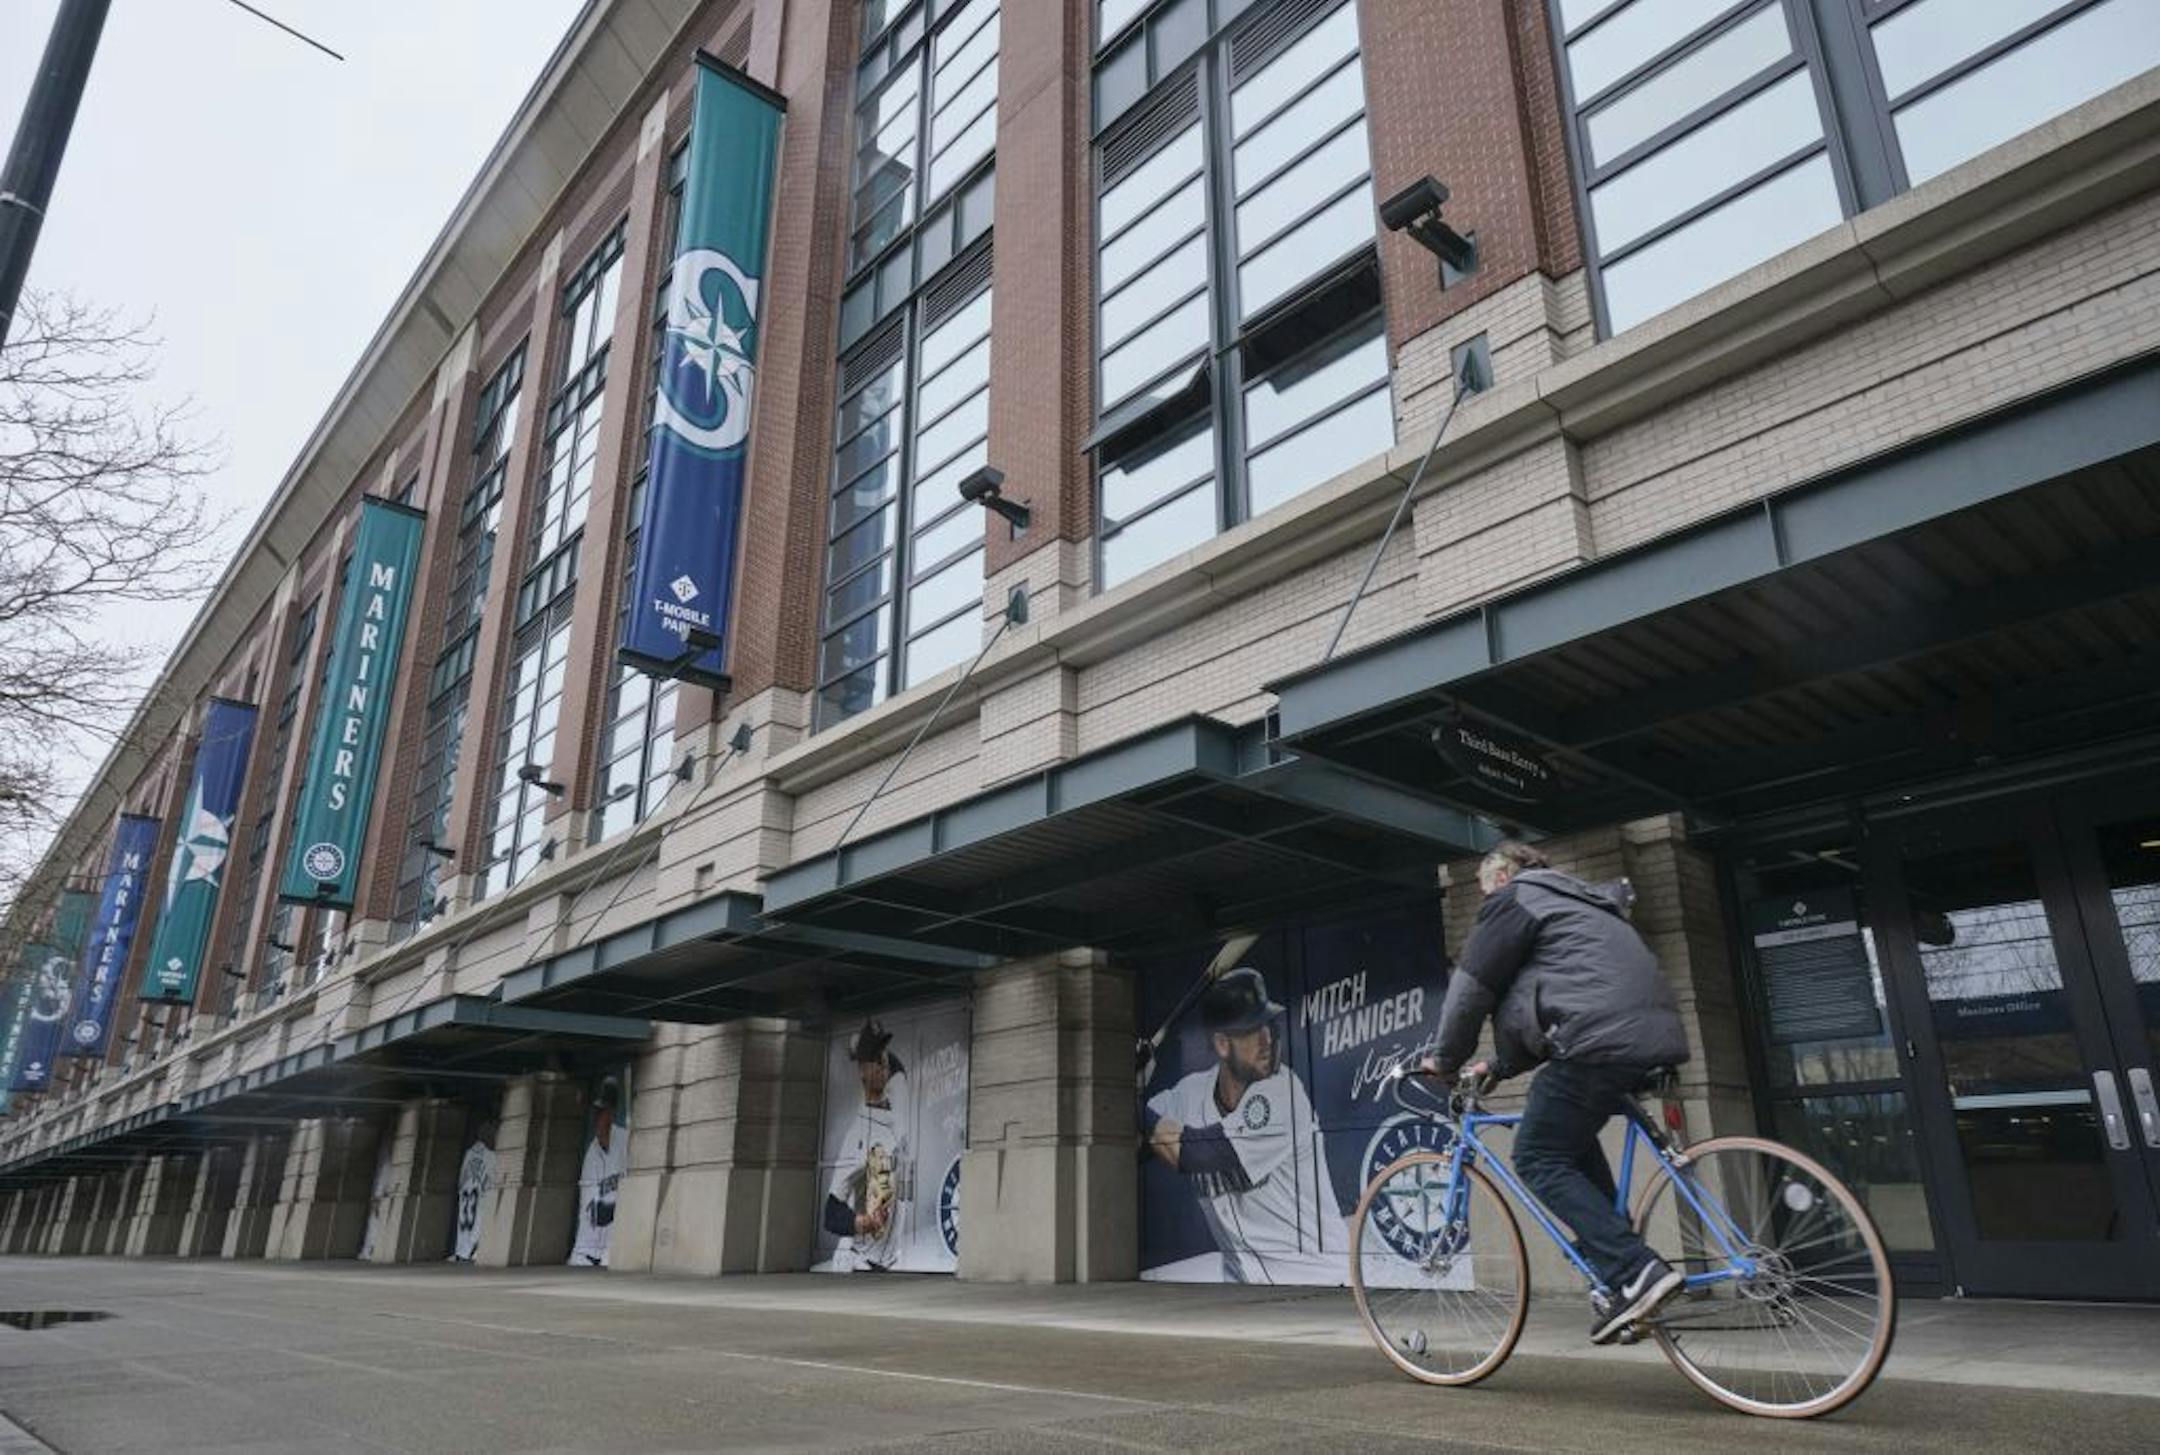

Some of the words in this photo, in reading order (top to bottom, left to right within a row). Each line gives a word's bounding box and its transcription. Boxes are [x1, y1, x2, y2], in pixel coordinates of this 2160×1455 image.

[653, 598, 710, 627] T-MOBILE
[327, 562, 397, 811] MARINERS
[1459, 729, 1488, 753] Third
[89, 852, 140, 1004] MARINERS
[1301, 970, 1367, 1029] MITCH
[1323, 985, 1424, 1058] HANIGER
[2006, 1001, 2042, 1014] Office
[1373, 1124, 1456, 1173] SEATT
